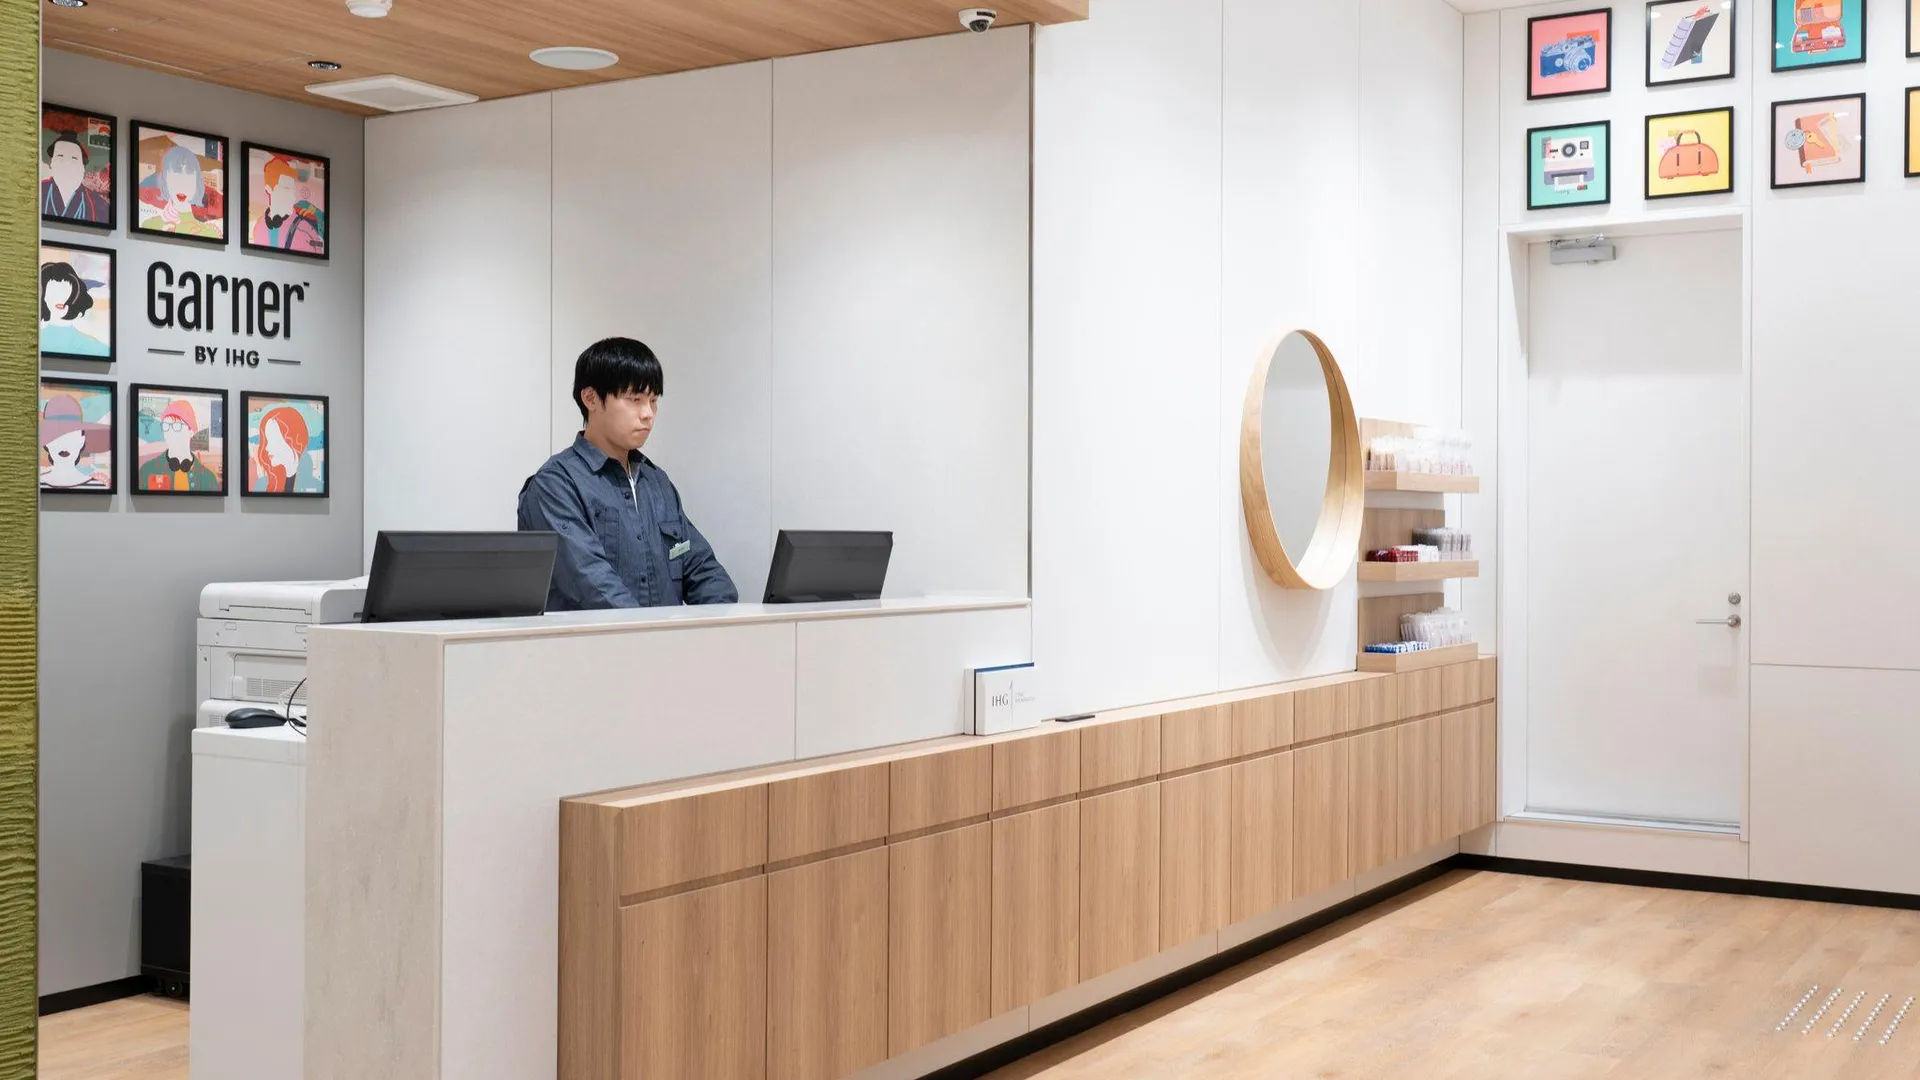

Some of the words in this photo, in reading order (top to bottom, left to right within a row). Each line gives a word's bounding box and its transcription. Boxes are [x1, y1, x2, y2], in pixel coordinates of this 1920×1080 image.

[195, 345, 217, 363] BY
[226, 348, 260, 367] IHG
[992, 693, 1009, 707] IHG
